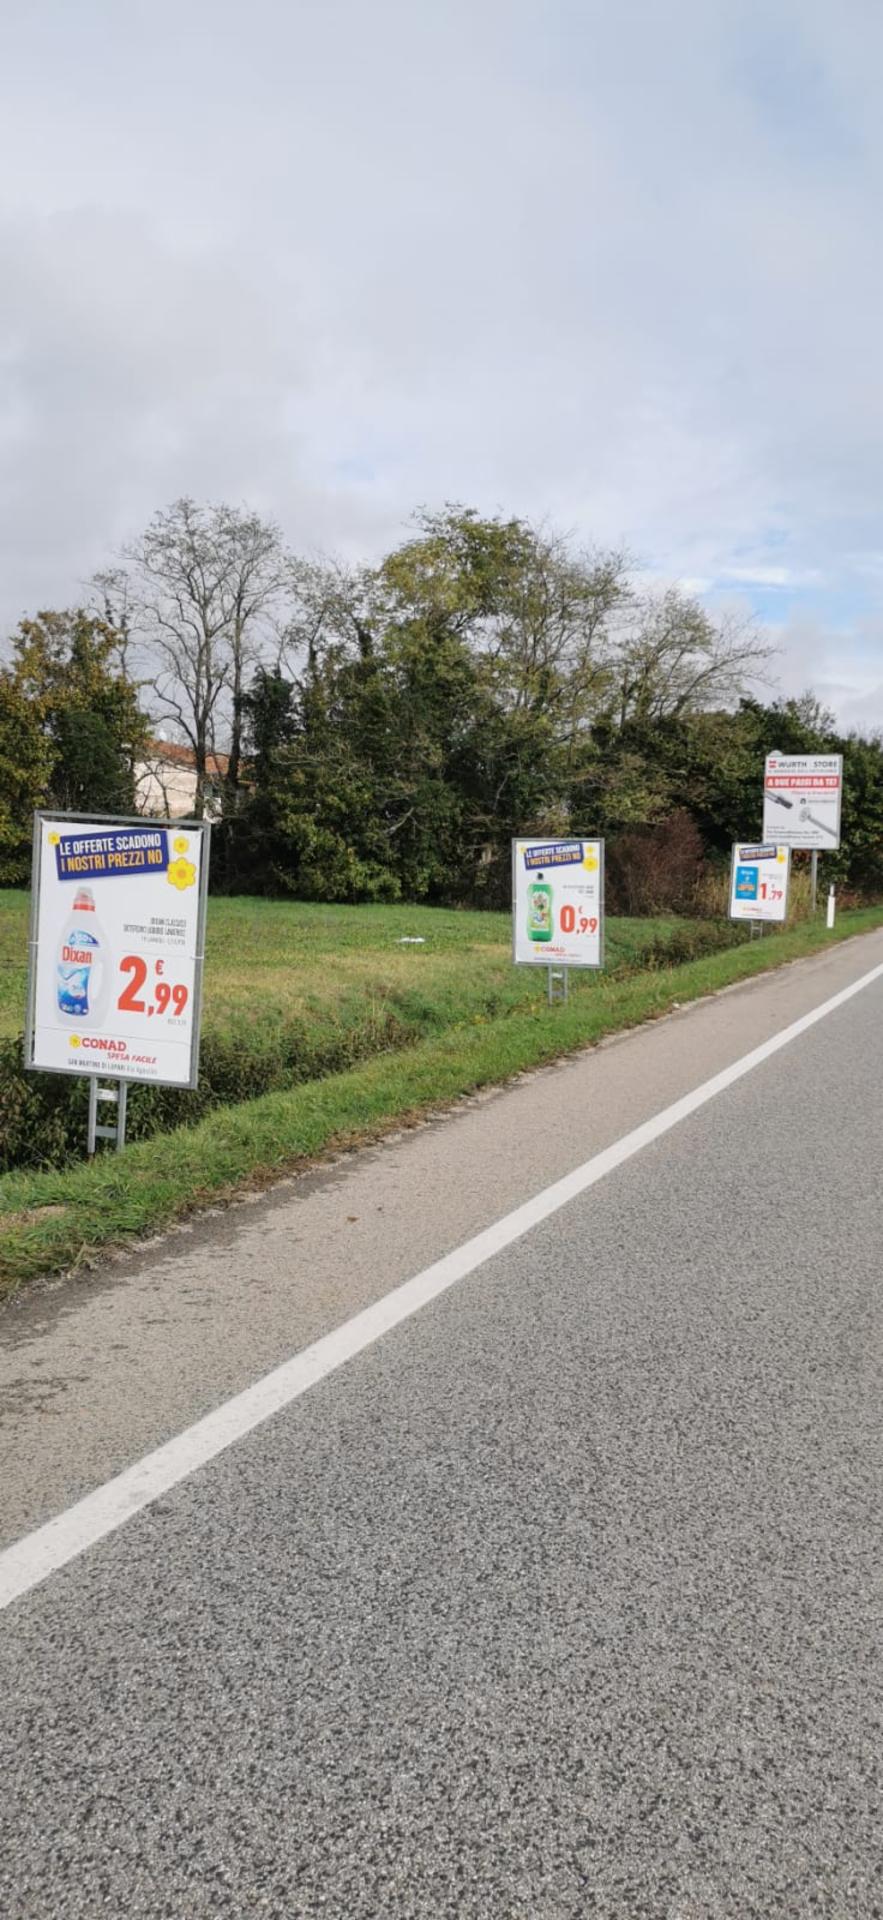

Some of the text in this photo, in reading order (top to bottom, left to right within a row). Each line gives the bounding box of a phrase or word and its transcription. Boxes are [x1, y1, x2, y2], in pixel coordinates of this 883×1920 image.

[814, 760, 837, 768] STORE
[60, 833, 162, 856] LE OFFERTE SCADONO
[61, 849, 163, 872] I NOSTRI PREZZI NO
[560, 904, 598, 934] 0,99
[62, 945, 93, 964] Dixan
[117, 955, 188, 1017] 2,99
[81, 1037, 127, 1052] CONAD
[106, 1051, 158, 1065] SPESA FACILE
